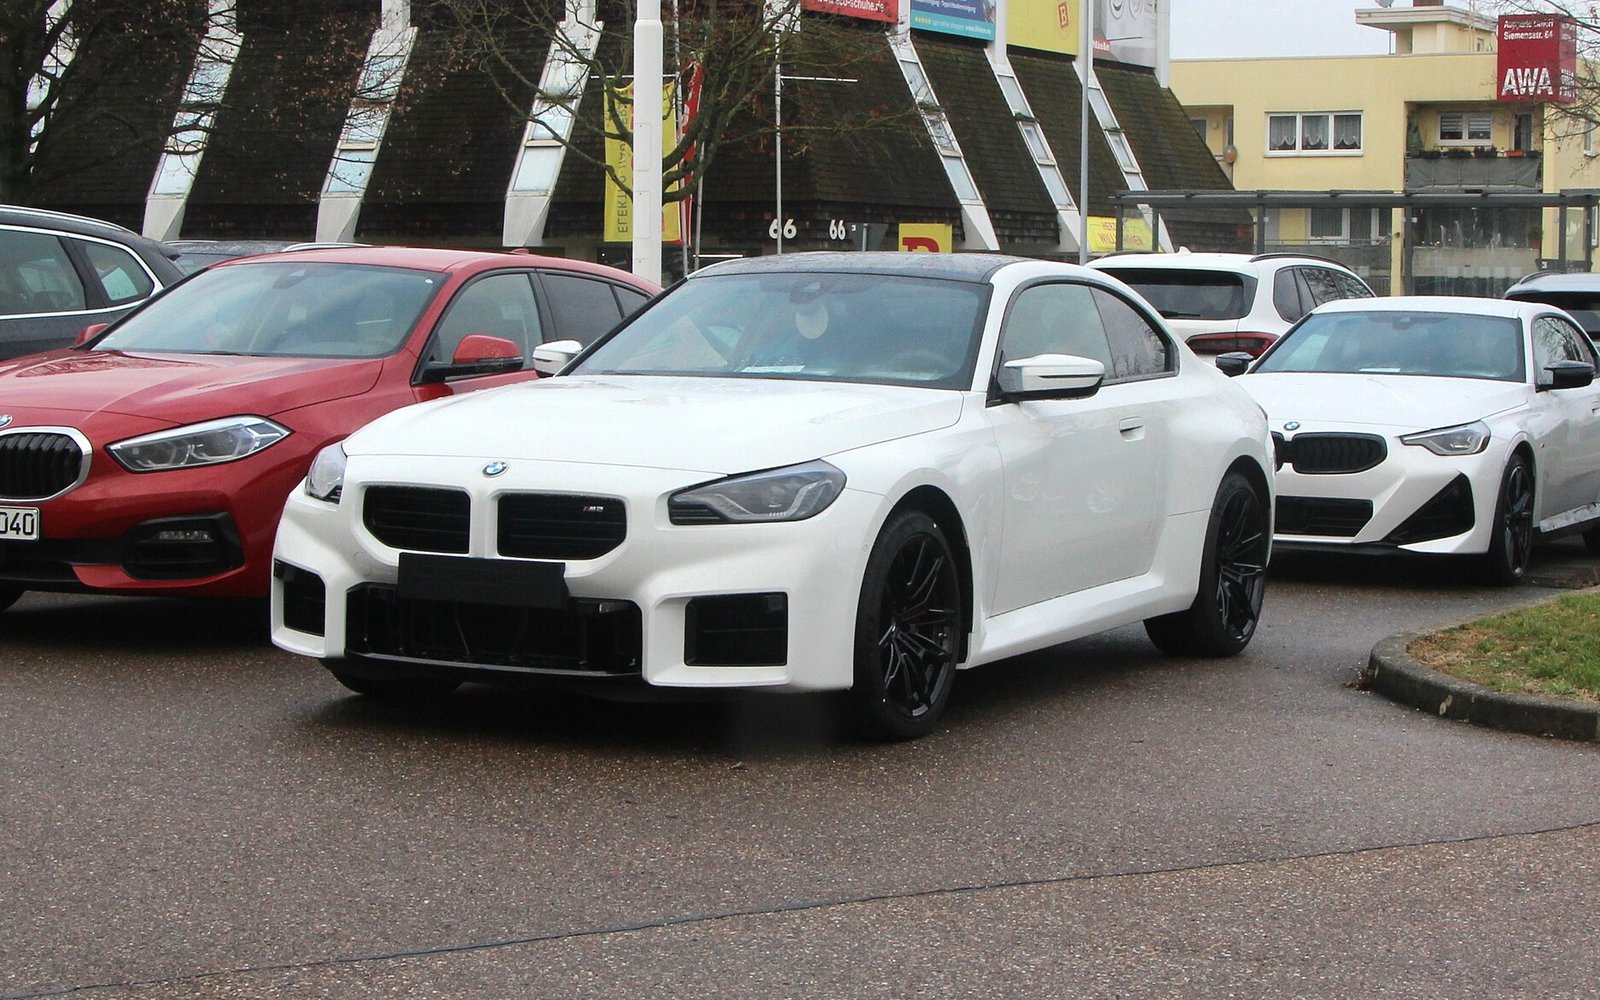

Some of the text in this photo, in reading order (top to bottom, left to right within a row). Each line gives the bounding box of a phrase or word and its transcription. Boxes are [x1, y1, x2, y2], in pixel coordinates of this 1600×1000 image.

[1501, 67, 1553, 96] AWA
[768, 218, 797, 239] 66
[829, 219, 846, 240] 66
